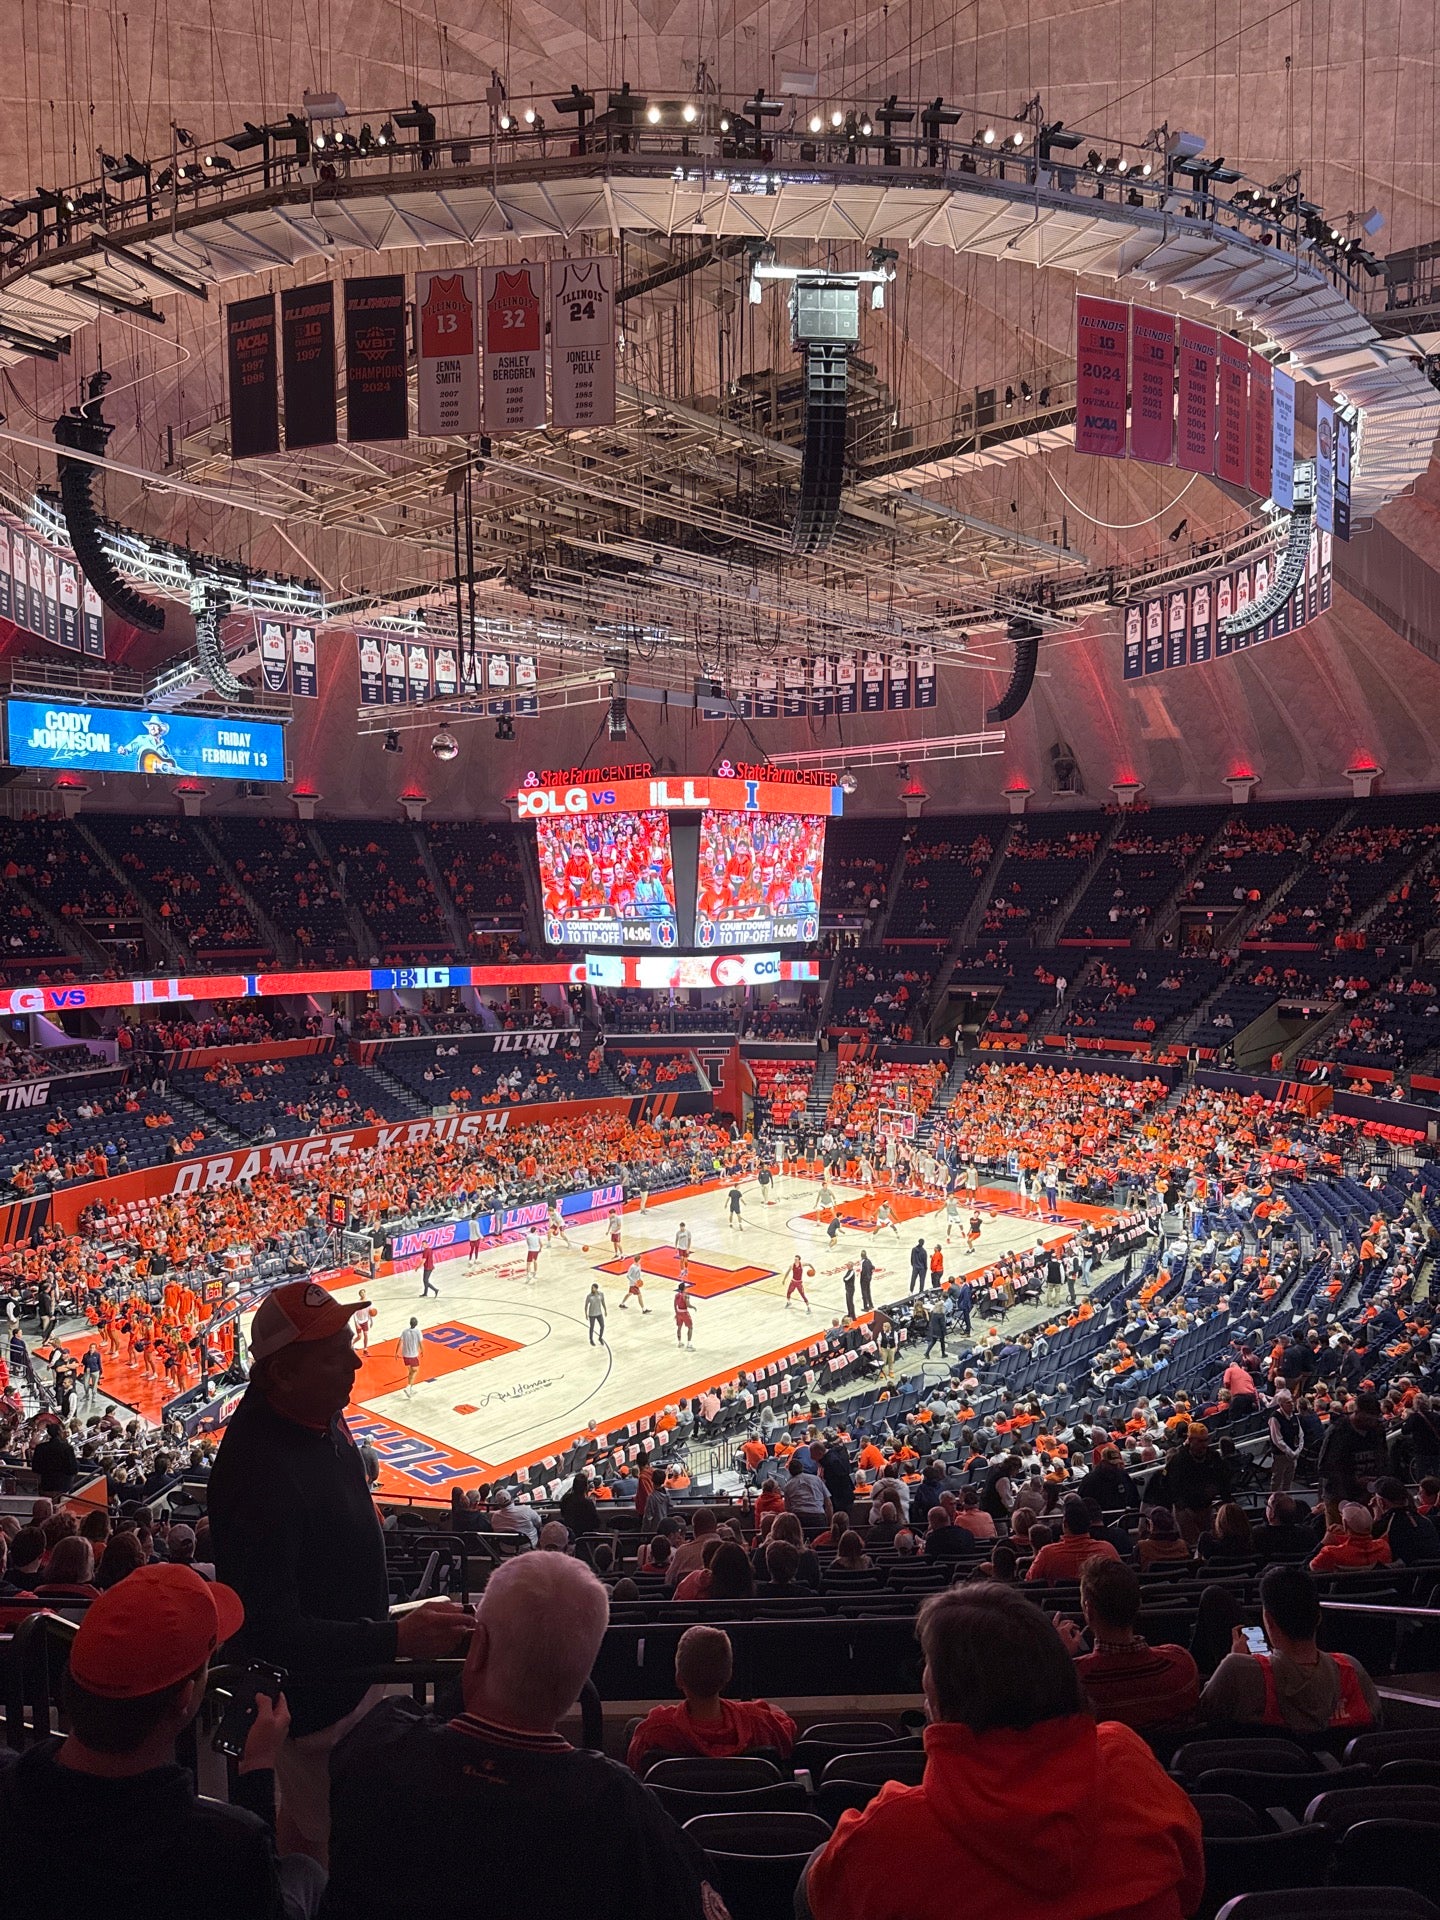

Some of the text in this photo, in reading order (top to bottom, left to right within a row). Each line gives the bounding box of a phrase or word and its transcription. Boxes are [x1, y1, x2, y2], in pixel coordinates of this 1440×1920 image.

[494, 296, 533, 312] ILLINOIS
[562, 289, 603, 306] ILLINOIS
[428, 300, 466, 316] ILLINOIS
[570, 301, 595, 321] 24
[437, 314, 458, 334] 13
[502, 309, 526, 329] 32
[1080, 316, 1126, 332] ILLINOIS
[236, 333, 269, 351] NCAA
[1135, 326, 1172, 342] ILLINOIS
[355, 337, 395, 350] WBIT
[1182, 338, 1215, 356] ILLINOIS
[296, 348, 322, 362] 1997
[498, 356, 530, 368] ASHLEY
[565, 350, 601, 364] JONELLE
[241, 359, 265, 373] 1997
[349, 365, 404, 381] CHAMPIONS
[436, 360, 461, 372] JENNA
[492, 367, 536, 381] BERGGREN
[572, 362, 594, 374] POLK
[1083, 362, 1121, 381] 2024
[436, 372, 462, 385] SMITH
[1082, 398, 1120, 410] OVERALL
[1084, 416, 1118, 431] NCAA
[1220, 597, 1229, 608] 30
[45, 710, 92, 733] CODY
[28, 728, 110, 754] JOHNSON
[217, 730, 251, 748] FRIDAY
[202, 748, 268, 767] FEBRUARY 13
[600, 763, 652, 781] CENTER
[795, 770, 838, 786] CENTER
[592, 792, 616, 806] VS
[650, 781, 711, 807] ILL
[566, 922, 651, 942] COUNTDOWN 14:06
[567, 931, 620, 944] TO TIP-OFF
[719, 921, 798, 938] COUNTDOWN 14:06
[720, 930, 770, 944] TO TIP-OFF
[51, 990, 86, 1006] VS
[132, 978, 194, 1005] ILL
[492, 1034, 560, 1053] ILLINI
